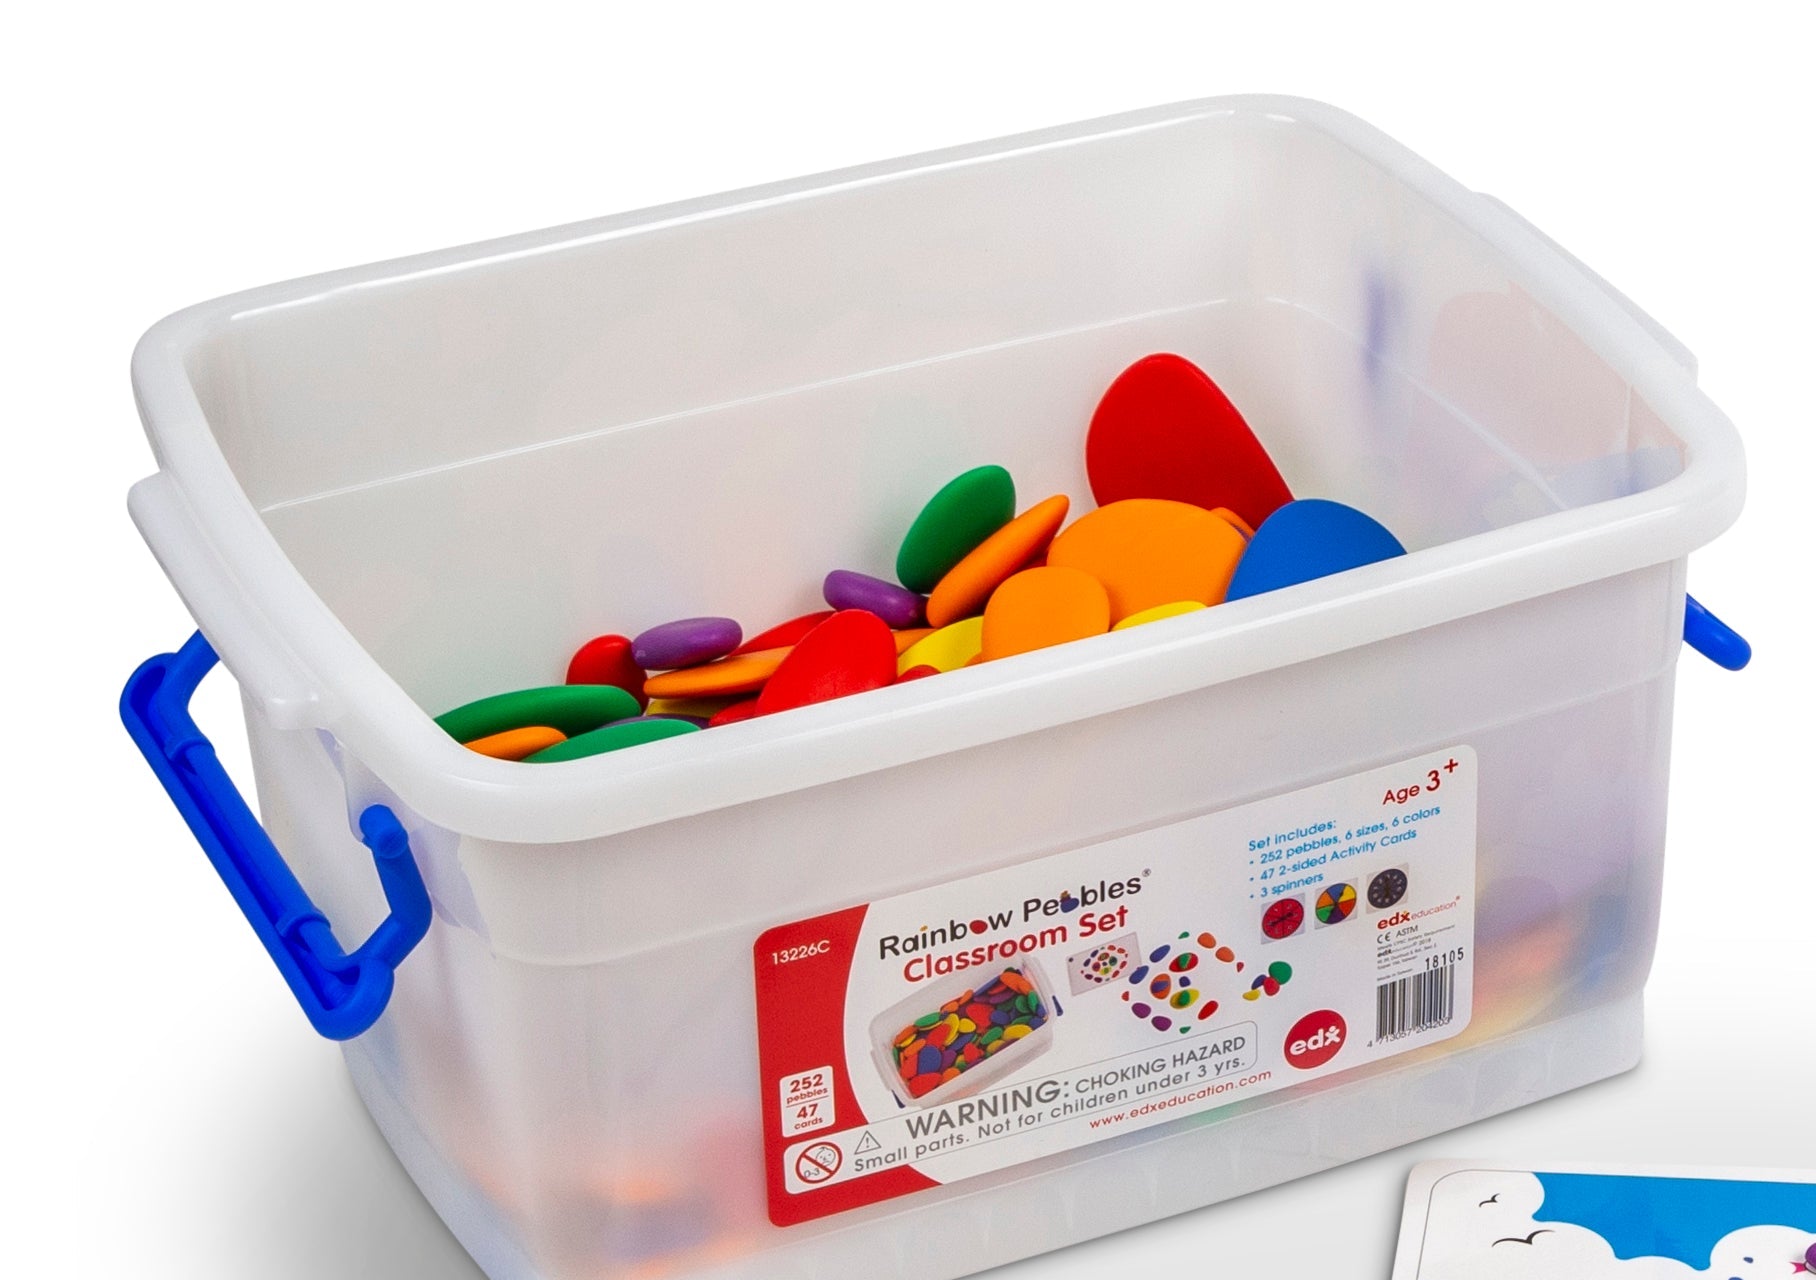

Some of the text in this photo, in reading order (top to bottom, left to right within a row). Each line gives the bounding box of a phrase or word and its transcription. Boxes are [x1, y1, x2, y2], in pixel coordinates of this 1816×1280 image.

[1383, 785, 1420, 805] Age
[1248, 819, 1337, 852] Set includes:
[1260, 806, 1441, 865] 252 pebbles, 6 sizes, 6 colors
[1260, 829, 1417, 881] 47 2-sided Activity Cards
[1260, 873, 1324, 898] 3 spinners
[879, 910, 1013, 959] Rainbow
[903, 905, 1128, 983] Classroom Set
[1396, 925, 1419, 938] ASTM
[772, 940, 831, 965] 13226C
[1425, 947, 1464, 970] 18105
[1289, 1025, 1340, 1056] edx
[786, 1087, 828, 1104] pebbles
[790, 1073, 824, 1094] 252
[905, 1036, 1246, 1139] WARNING: CHOKING HAZARD
[796, 1103, 819, 1119] 47
[1089, 1070, 1272, 1129] www.edxeducation.com
[794, 1116, 823, 1130] cards
[854, 1056, 1245, 1172] Small parts. Not for children under 3 yrs.
